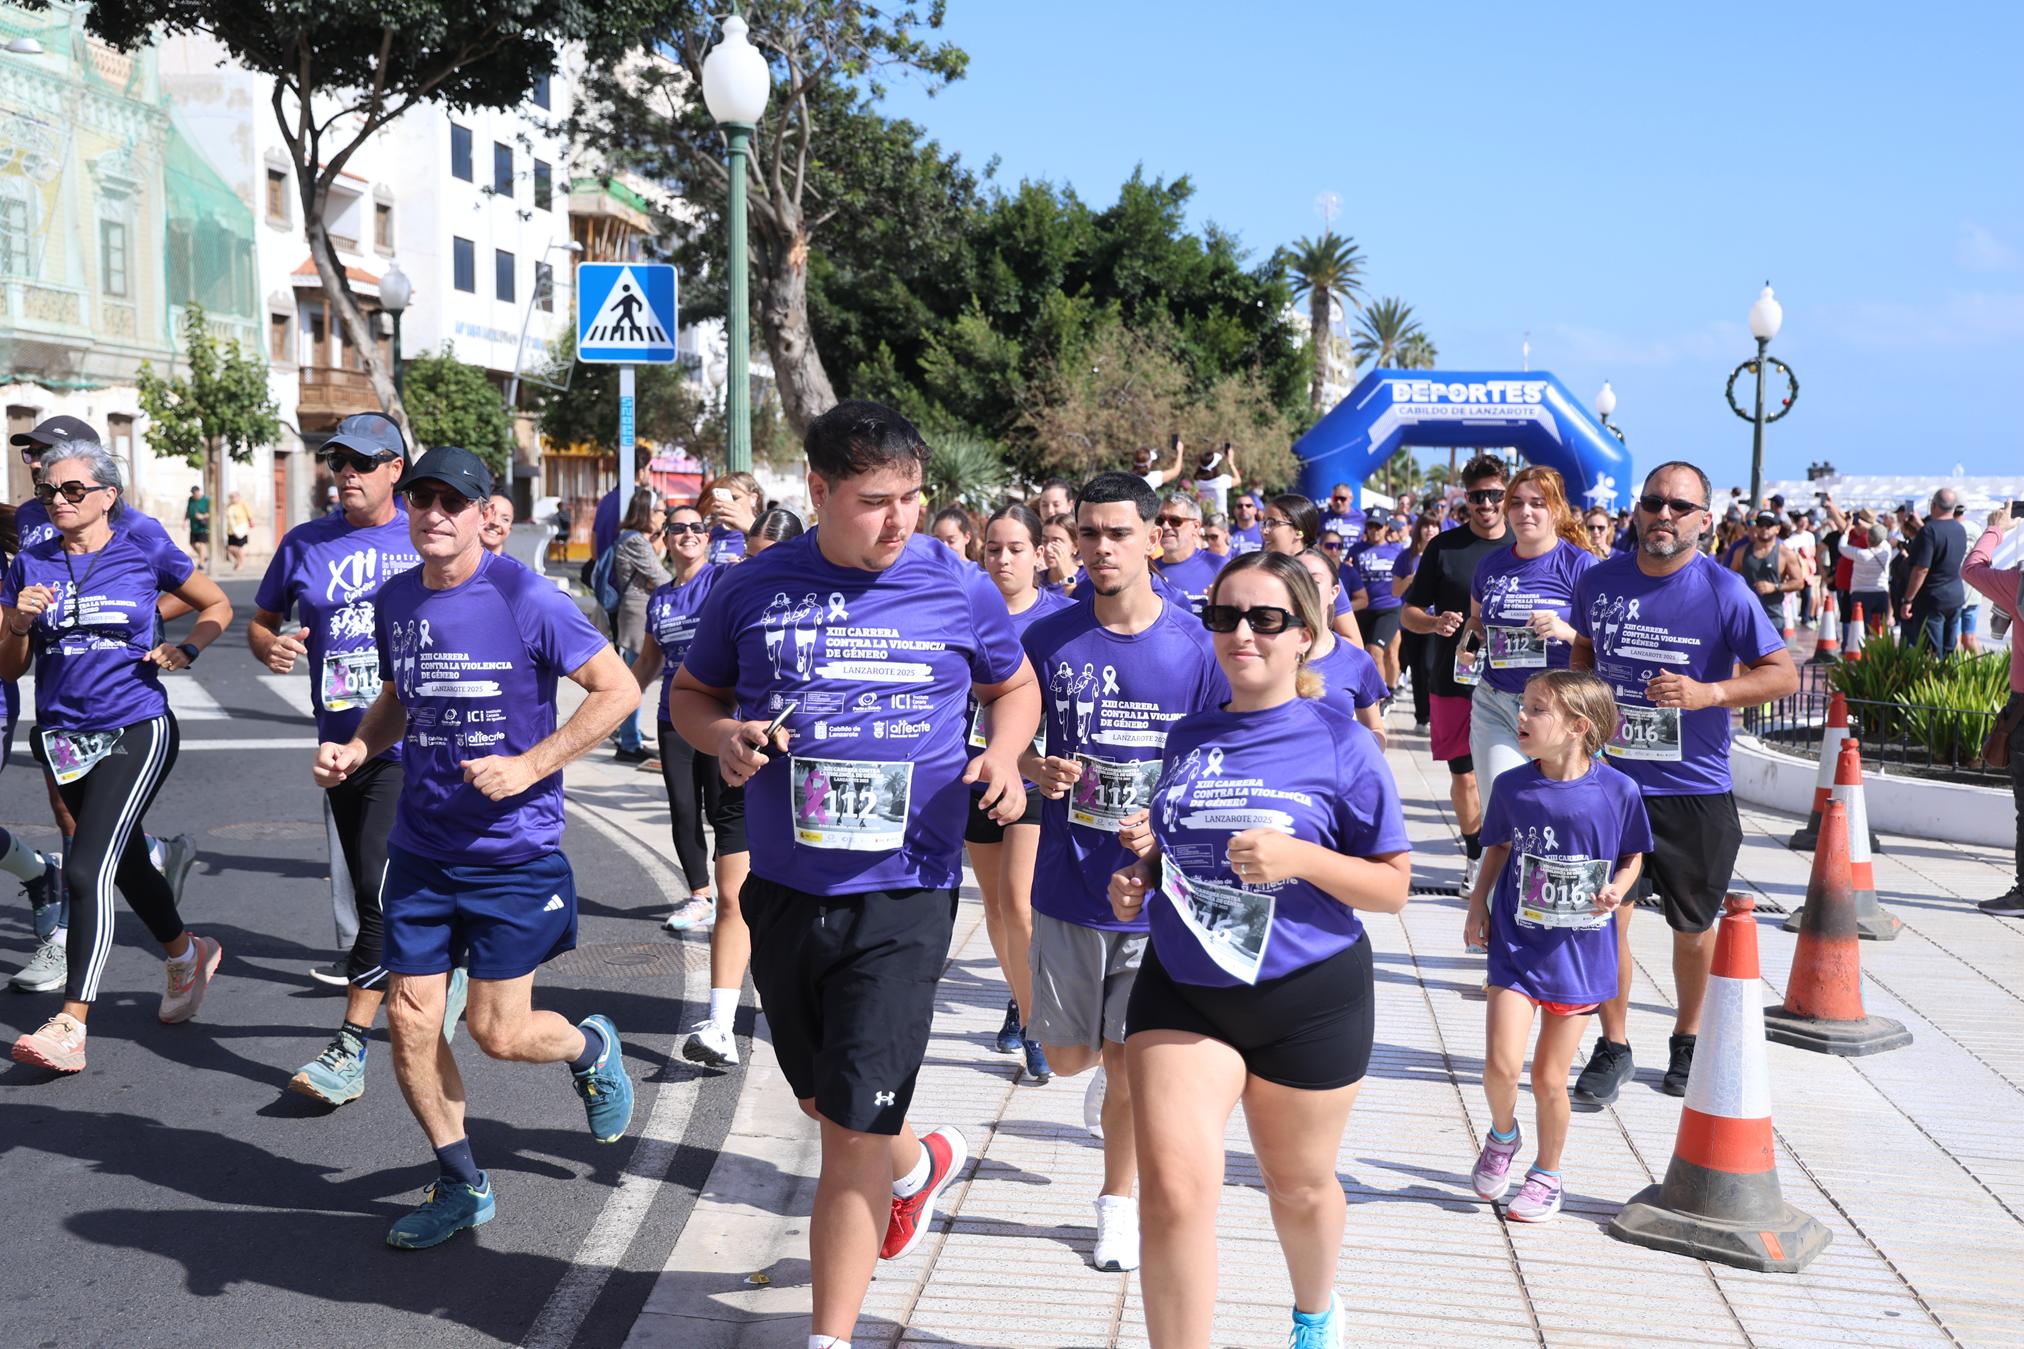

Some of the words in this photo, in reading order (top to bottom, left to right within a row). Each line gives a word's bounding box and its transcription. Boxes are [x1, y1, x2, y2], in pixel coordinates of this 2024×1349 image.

[1392, 382, 1543, 404] DEPORTES
[1399, 406, 1448, 416] CABILDO
[1452, 407, 1465, 416] DE
[1470, 407, 1536, 417] LANZAROTE
[382, 552, 421, 561] Contra
[826, 627, 846, 636] XIII
[847, 628, 900, 638] CARRERA
[1624, 623, 1636, 631] XIII
[1636, 625, 1668, 634] CARRERA
[1622, 630, 1650, 640] CONTRA
[1660, 635, 1701, 645] VIOLENCIA
[1631, 638, 1659, 648] GÉNERO
[826, 638, 872, 648] CONTRA
[873, 639, 888, 648] LA
[889, 640, 946, 651] VIOLENCIA
[1504, 637, 1530, 652] 112
[433, 652, 470, 660] CARRERA
[826, 648, 841, 658] DE
[842, 646, 888, 660] GÉNERO
[1630, 650, 1663, 658] LANZAROTE
[420, 662, 450, 670] CONTRA
[450, 662, 460, 670] LA
[461, 662, 513, 670] VIOLENCIA
[843, 666, 895, 676] LANZAROTE
[897, 669, 916, 677] 2025
[431, 670, 460, 680] GÉNERO
[891, 694, 910, 709] ICI
[1101, 700, 1118, 708] XIII
[1118, 701, 1159, 711] CARRERA
[467, 710, 484, 722] ICI
[1101, 710, 1137, 720] CONTRA
[1137, 712, 1150, 720] LA
[1150, 713, 1187, 721] VIOLEN
[1100, 719, 1112, 727] DE
[1113, 718, 1149, 729] GÉNERO
[1112, 734, 1153, 742] LANZAROTE
[1622, 723, 1659, 742] 016
[1195, 780, 1214, 788] XIII
[1215, 779, 1264, 788] CARRERA
[1095, 785, 1138, 808] 112
[1193, 788, 1233, 799] CONTRA
[1234, 788, 1249, 796] LA
[1250, 788, 1312, 807] VIOLENCIA
[824, 790, 878, 819] 112
[1205, 798, 1247, 807] GÉNERO
[1205, 815, 1252, 823] LANZAROTE
[1253, 816, 1272, 824] 2025
[1541, 882, 1586, 905] 016
[1184, 894, 1232, 944] 016
